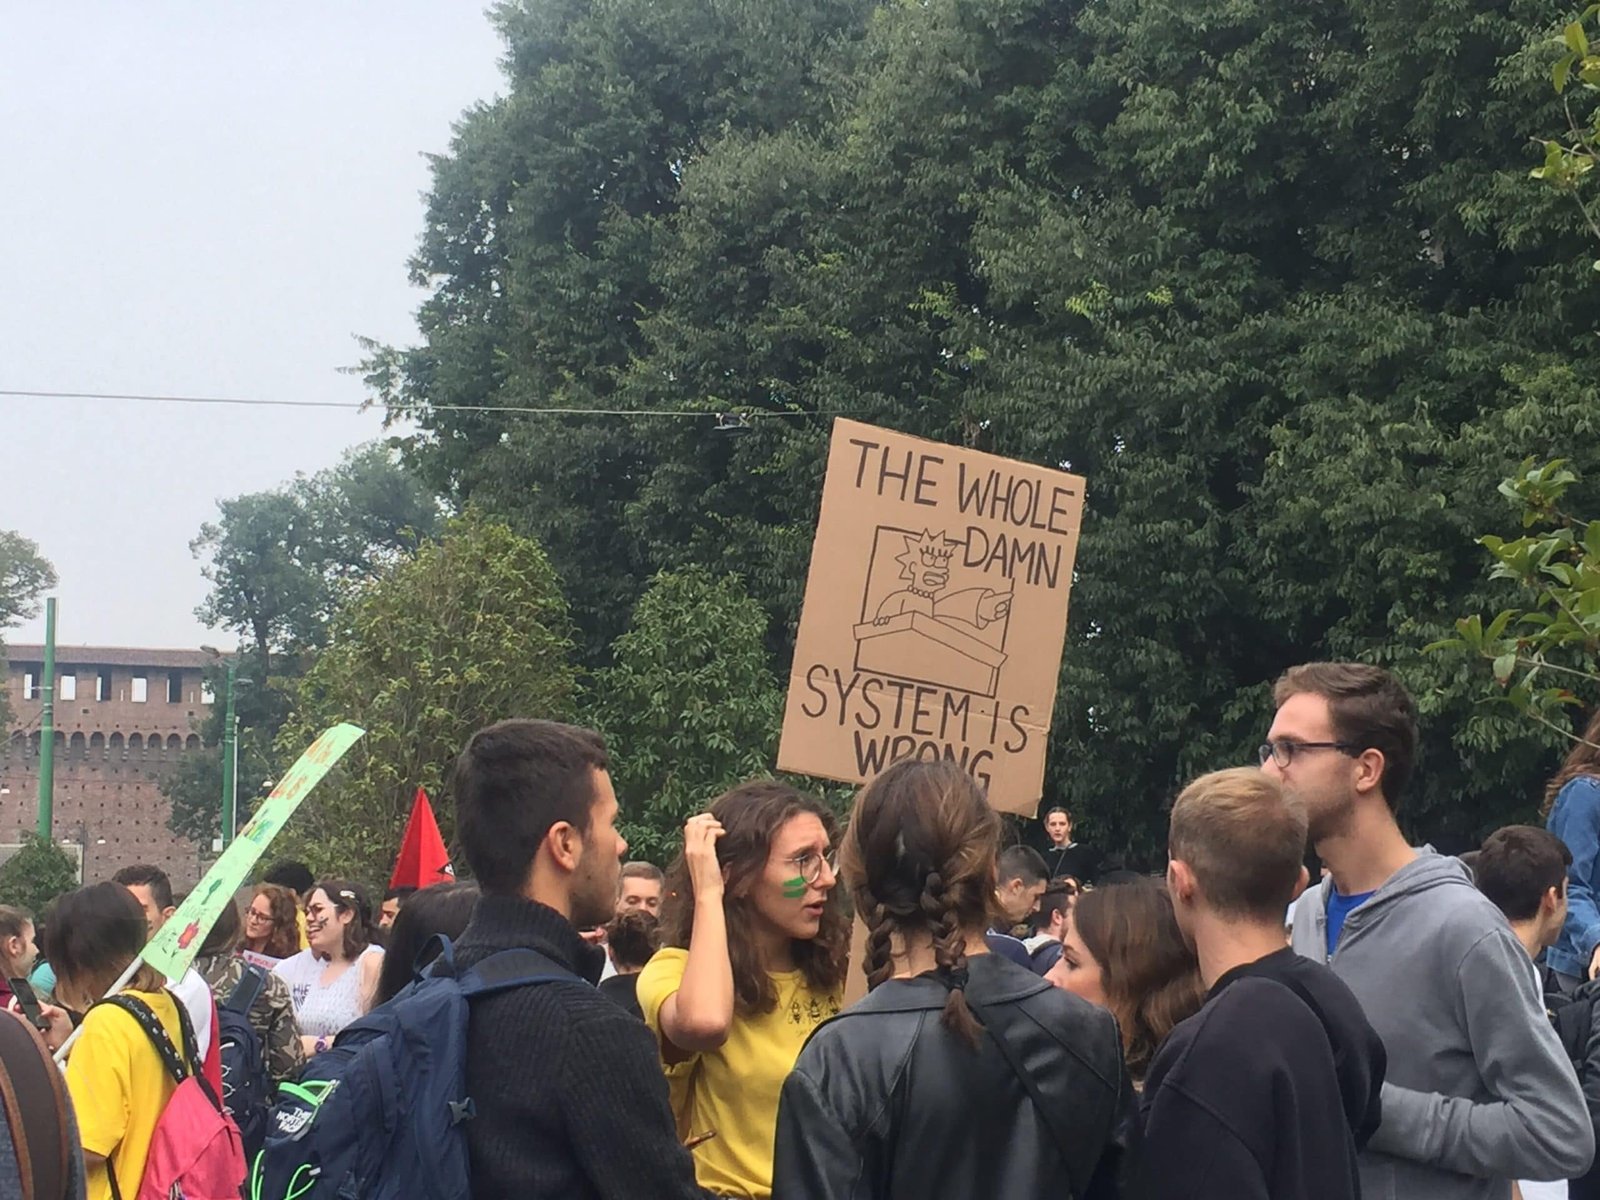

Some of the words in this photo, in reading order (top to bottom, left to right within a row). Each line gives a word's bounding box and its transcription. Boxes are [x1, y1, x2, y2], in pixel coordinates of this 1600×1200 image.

[850, 438, 944, 507] THE
[959, 462, 1075, 536] WHOLE
[963, 526, 1062, 589] DAMN
[801, 664, 971, 743] SYSTEM
[990, 701, 1030, 754] IS
